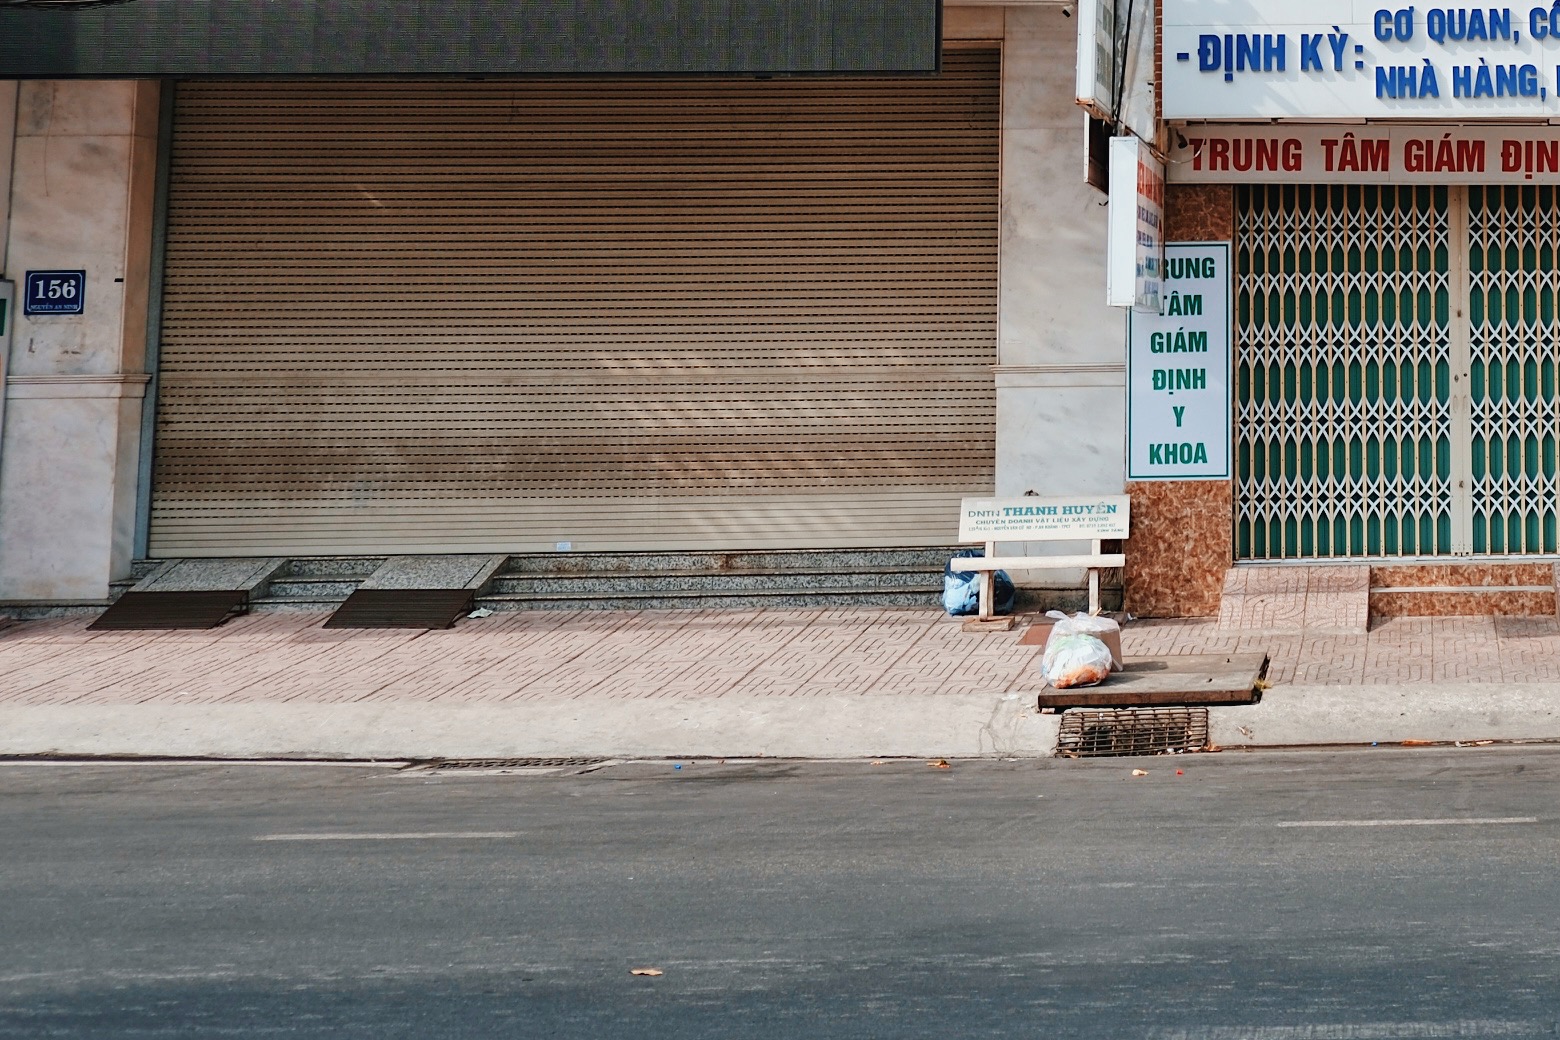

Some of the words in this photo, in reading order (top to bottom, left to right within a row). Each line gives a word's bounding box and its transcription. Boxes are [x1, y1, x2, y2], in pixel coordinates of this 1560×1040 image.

[1373, 5, 1415, 42] CƠ
[1197, 34, 1286, 83] ĐỊNH
[1374, 58, 1440, 100] NHÀ
[1189, 138, 1302, 173] TRUNG
[1321, 131, 1390, 174] TÂM
[1403, 133, 1486, 175] GIÁM
[35, 279, 76, 299] 156
[1150, 326, 1208, 355] GIÁM
[1152, 368, 1207, 397] ĐỊNH
[1172, 406, 1186, 428] Y
[1148, 443, 1209, 466] KHOA
[1003, 506, 1058, 517] THANH
